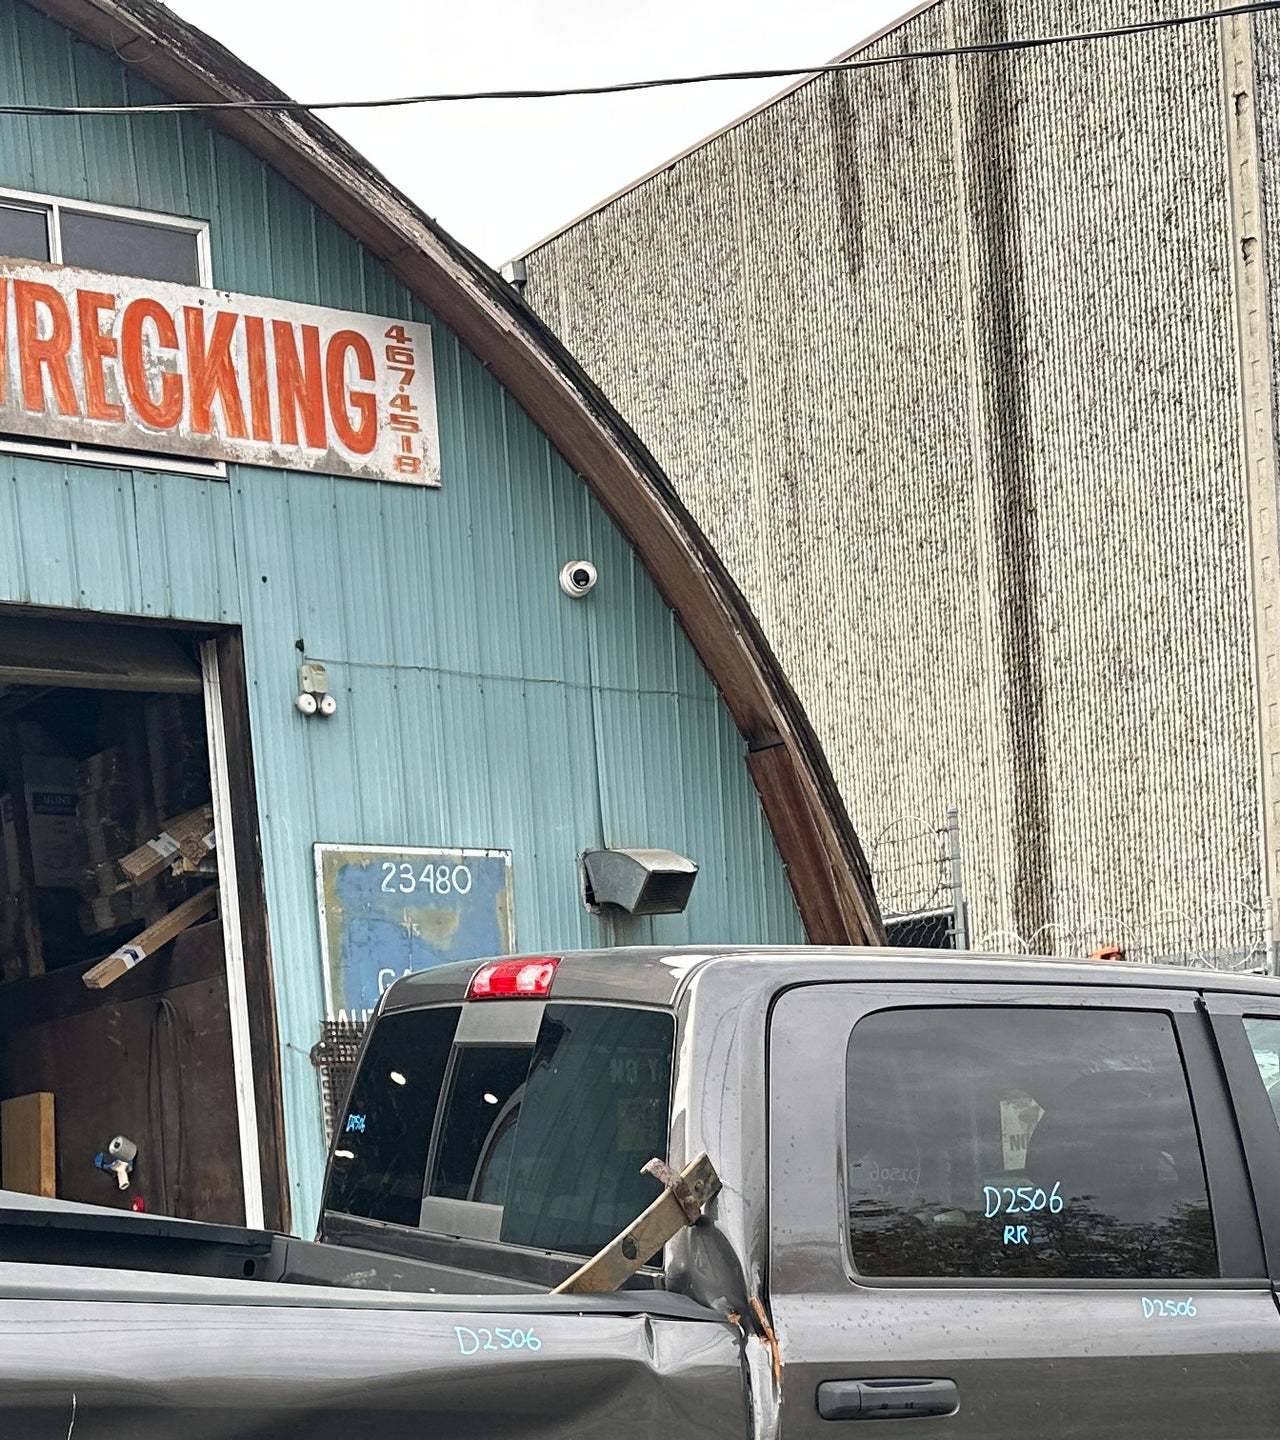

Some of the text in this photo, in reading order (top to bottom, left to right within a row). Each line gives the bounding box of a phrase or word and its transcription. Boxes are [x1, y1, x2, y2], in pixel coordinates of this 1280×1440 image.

[381, 861, 472, 895] 23480
[983, 1181, 1063, 1218] D2506
[1003, 1225, 1029, 1245] RR
[1141, 1296, 1197, 1318] D2506
[454, 1326, 542, 1355] D2506
